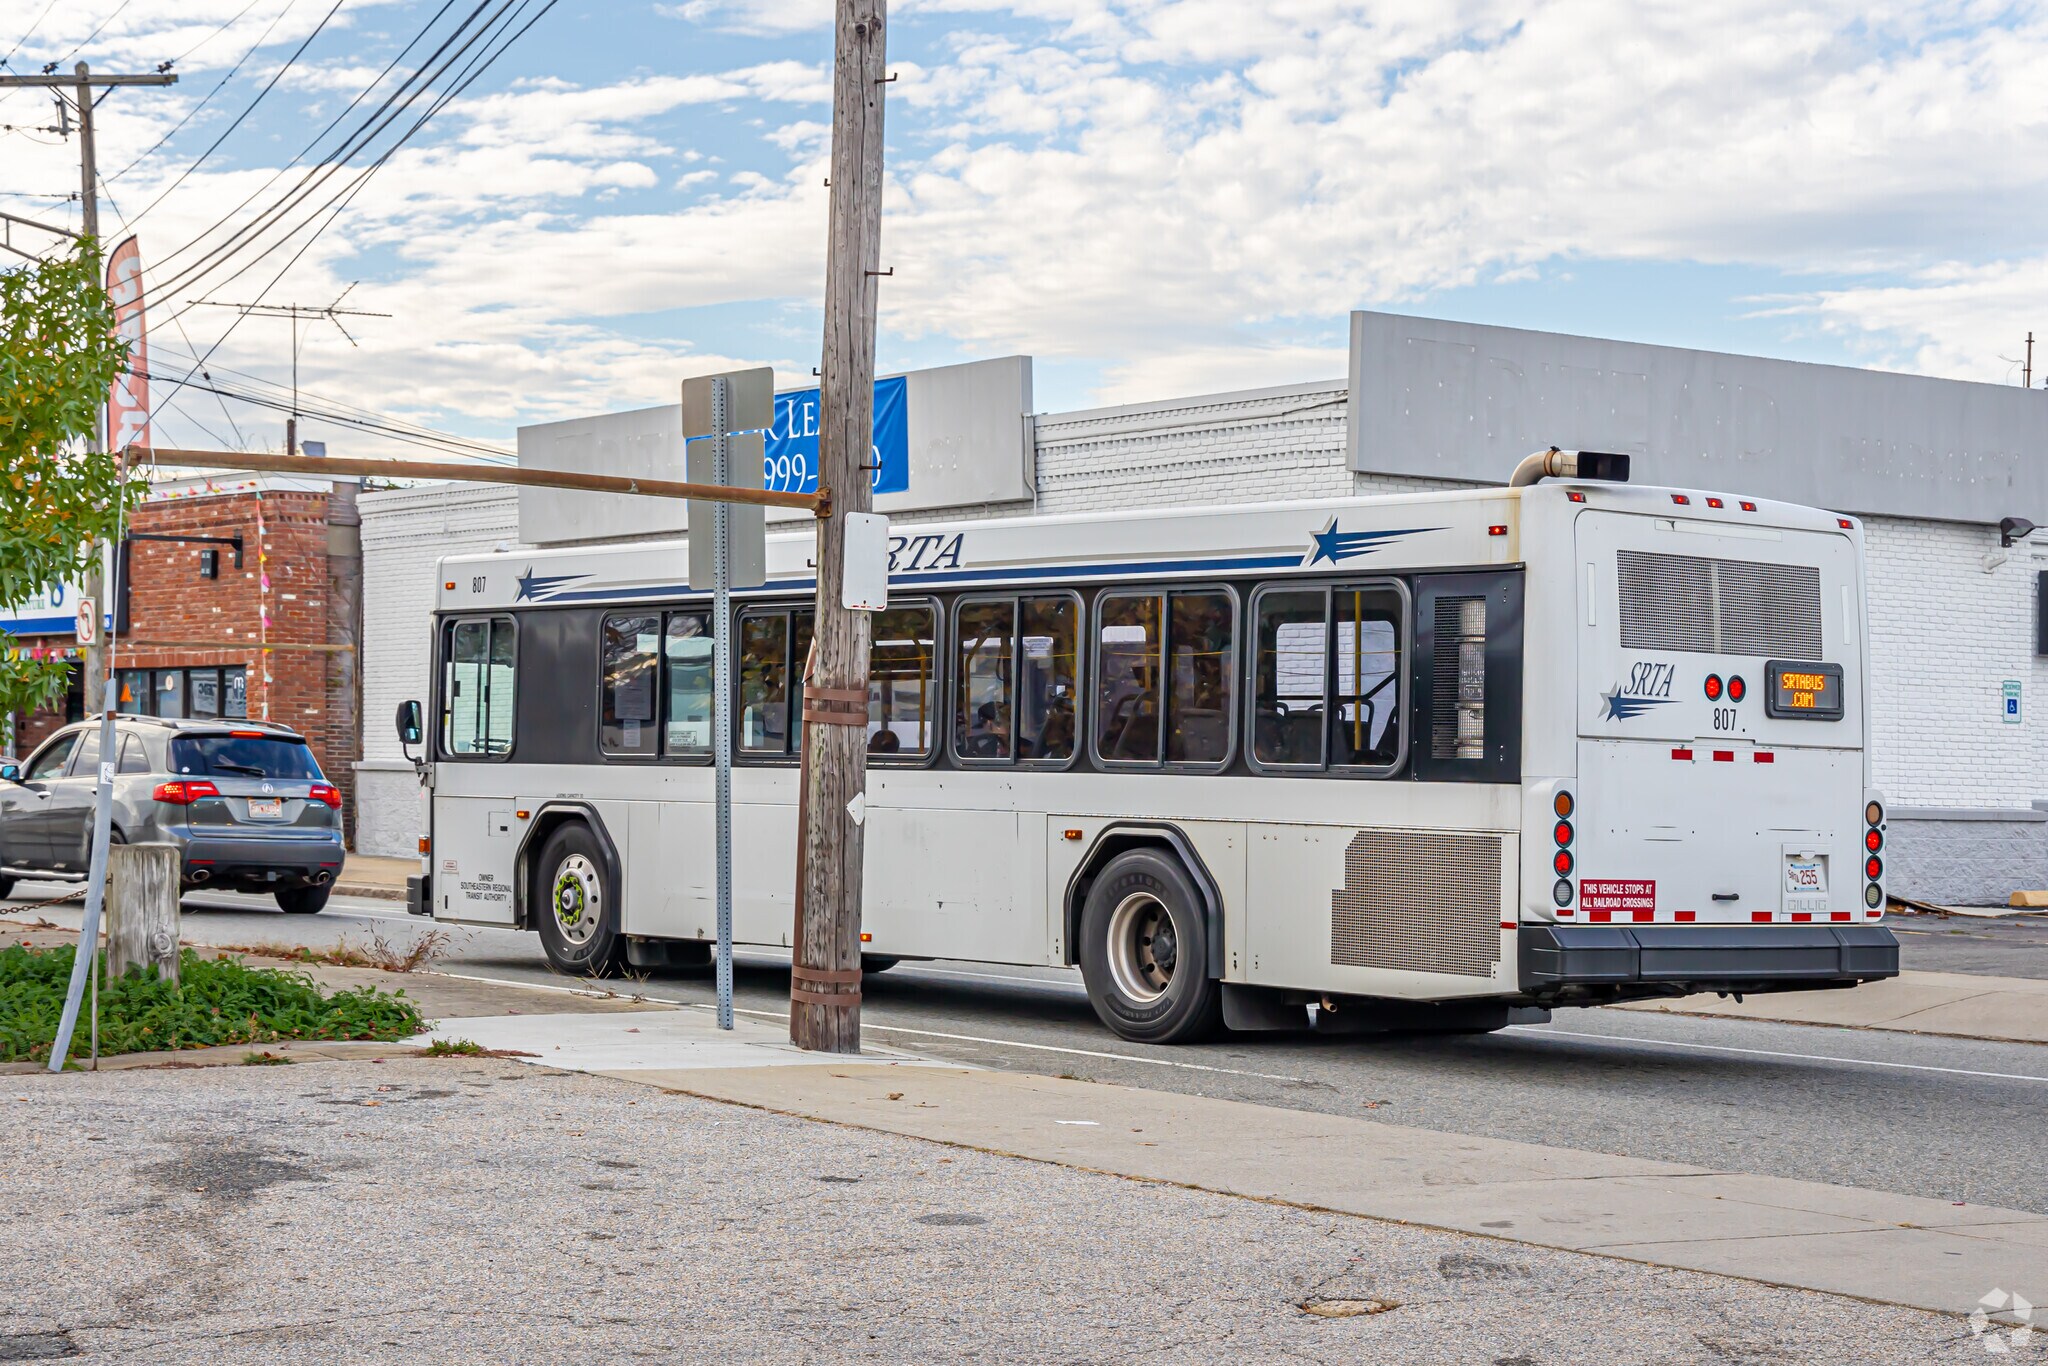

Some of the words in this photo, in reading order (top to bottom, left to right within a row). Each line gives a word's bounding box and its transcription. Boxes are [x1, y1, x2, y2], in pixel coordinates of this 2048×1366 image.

[787, 399, 820, 438] LE
[888, 533, 964, 572] RTA
[472, 576, 486, 593] 807
[1624, 661, 1675, 697] SRTA
[1782, 673, 1824, 690] SRTABUS
[1791, 692, 1814, 708] .COM
[1713, 708, 1736, 731] 807
[478, 873, 494, 882] OWNER
[1800, 870, 1818, 885] 255
[460, 881, 491, 891] SOUTHEASTERN
[492, 883, 512, 893] REGIONAL
[1583, 883, 1598, 894] THIS
[1599, 883, 1624, 894] VEHICLE
[1624, 884, 1644, 895] STOPS
[1645, 884, 1653, 894] AT
[466, 891, 483, 900] TRANSIT
[484, 892, 507, 902] AUTHORITY
[1582, 897, 1592, 908] ALL
[1593, 897, 1621, 908] RAILROAD
[1622, 897, 1653, 908] CROSSINGS
